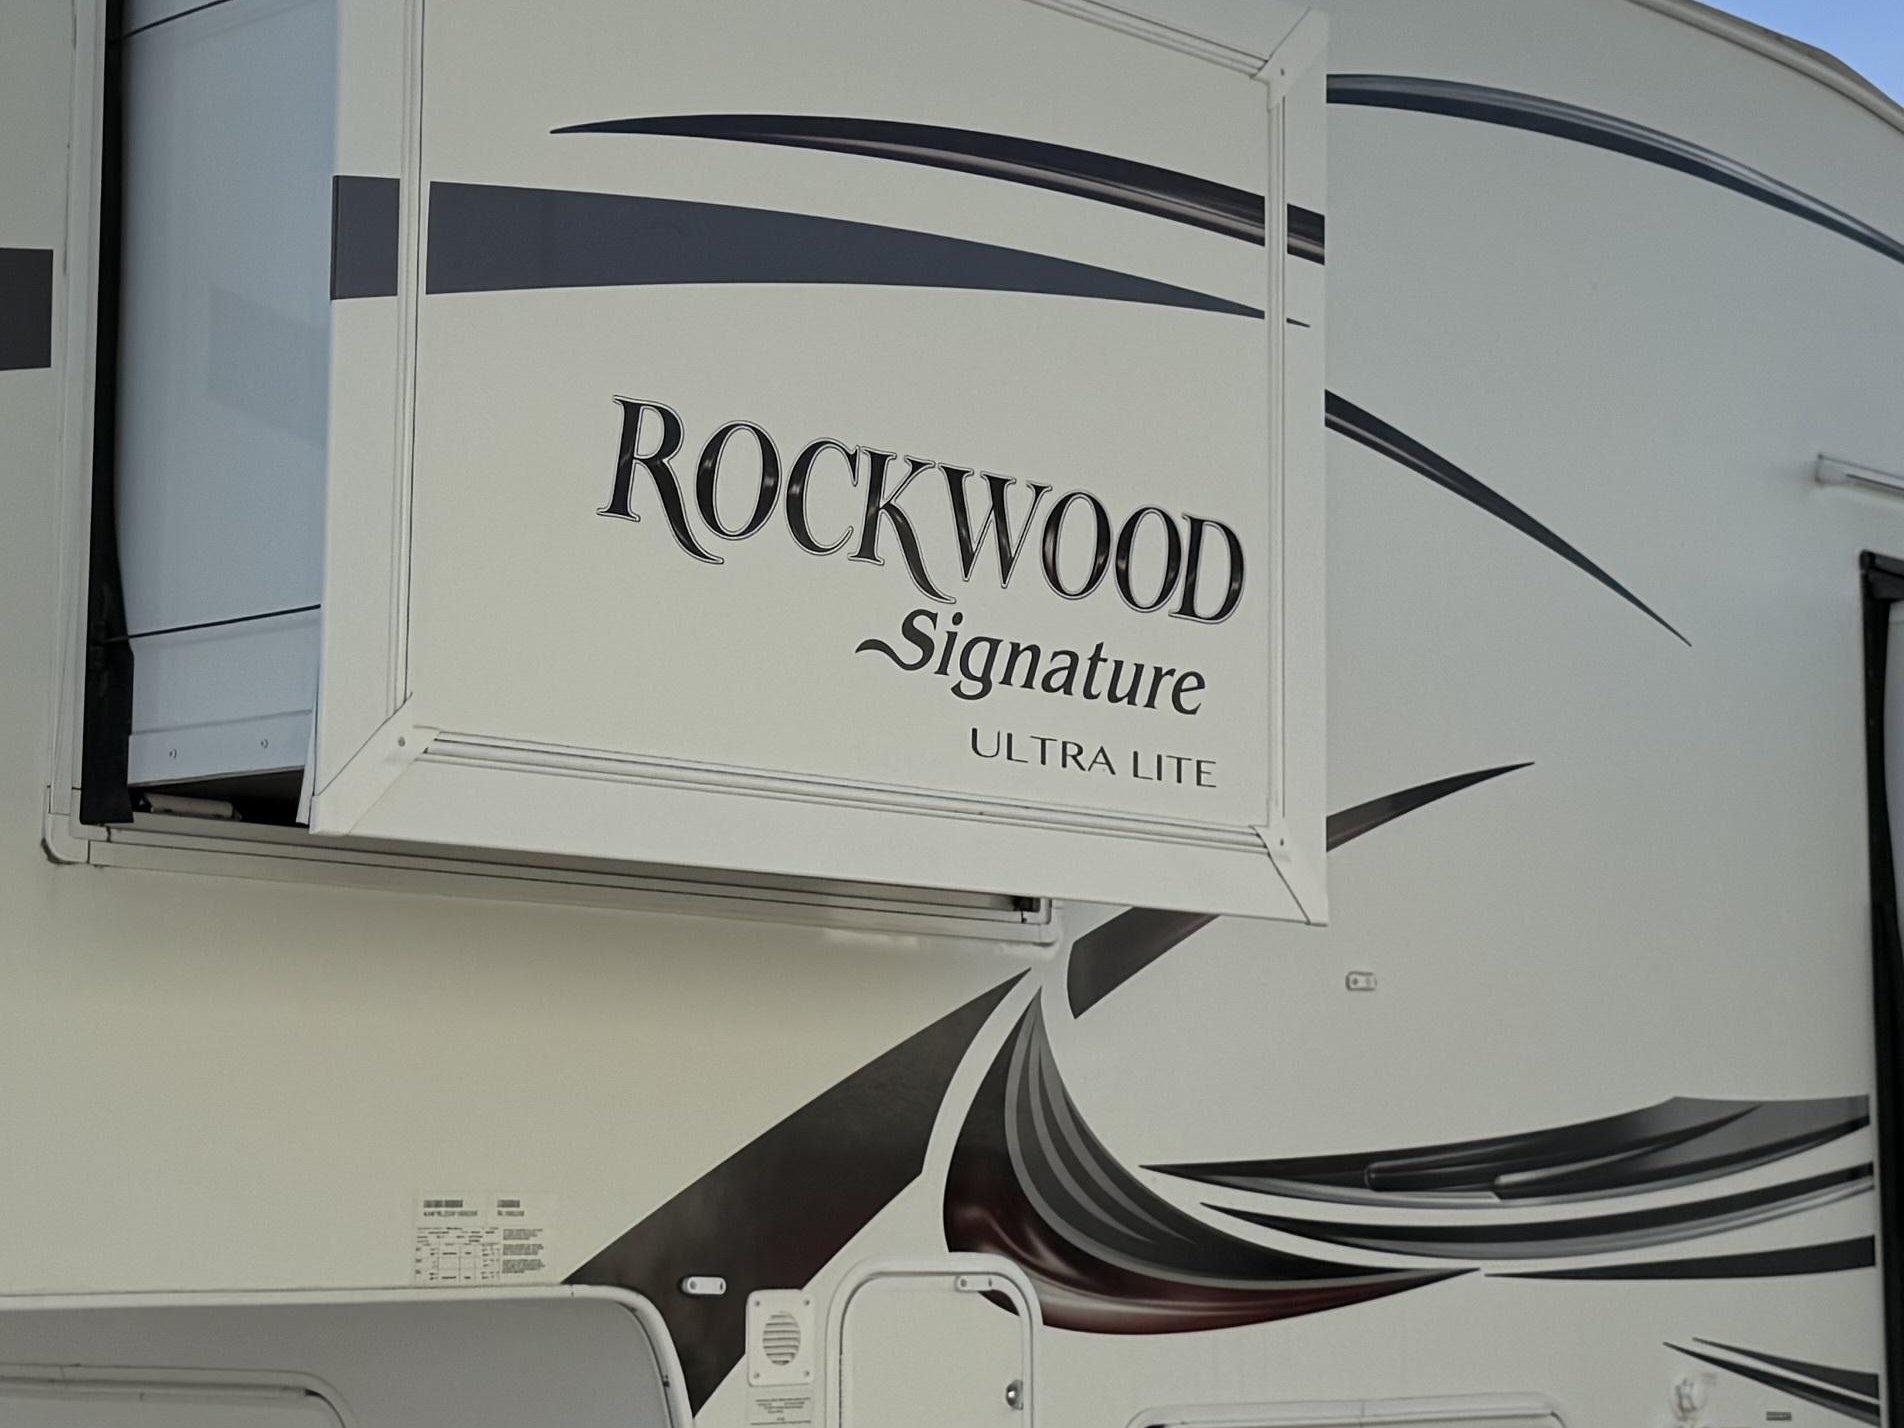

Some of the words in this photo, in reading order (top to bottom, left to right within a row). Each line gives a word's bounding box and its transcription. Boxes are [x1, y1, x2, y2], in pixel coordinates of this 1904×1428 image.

[596, 394, 1245, 624] ROCKWOOD
[855, 608, 1206, 715] Signature
[971, 727, 1116, 776] ULTRA
[1132, 750, 1217, 789] LITE
